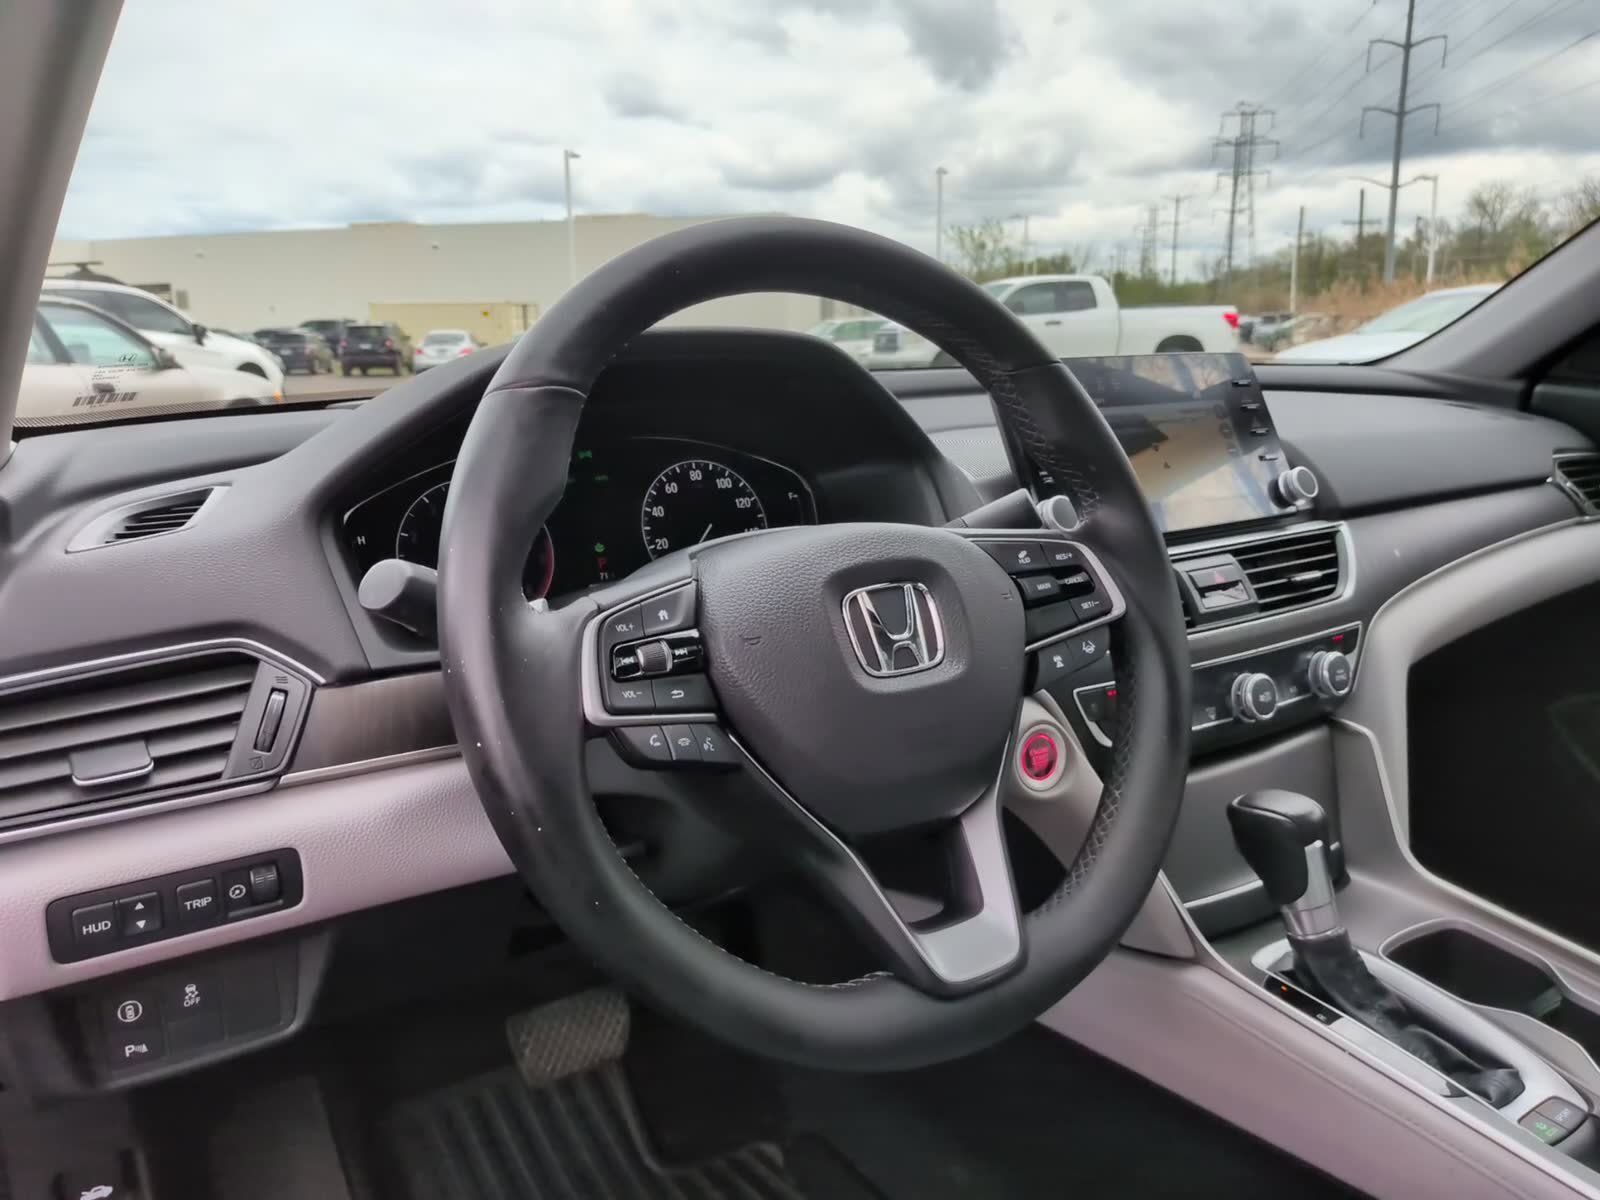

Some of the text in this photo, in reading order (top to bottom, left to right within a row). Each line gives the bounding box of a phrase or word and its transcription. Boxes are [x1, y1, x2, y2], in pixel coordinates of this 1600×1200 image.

[689, 469, 702, 481] 80
[665, 482, 678, 494] 60
[716, 478, 732, 489] 100
[735, 497, 751, 508] 120
[651, 506, 665, 517] 40
[655, 538, 669, 550] 20
[184, 896, 212, 910] TRIP
[82, 920, 111, 935] HUD
[183, 996, 200, 1007] OFF
